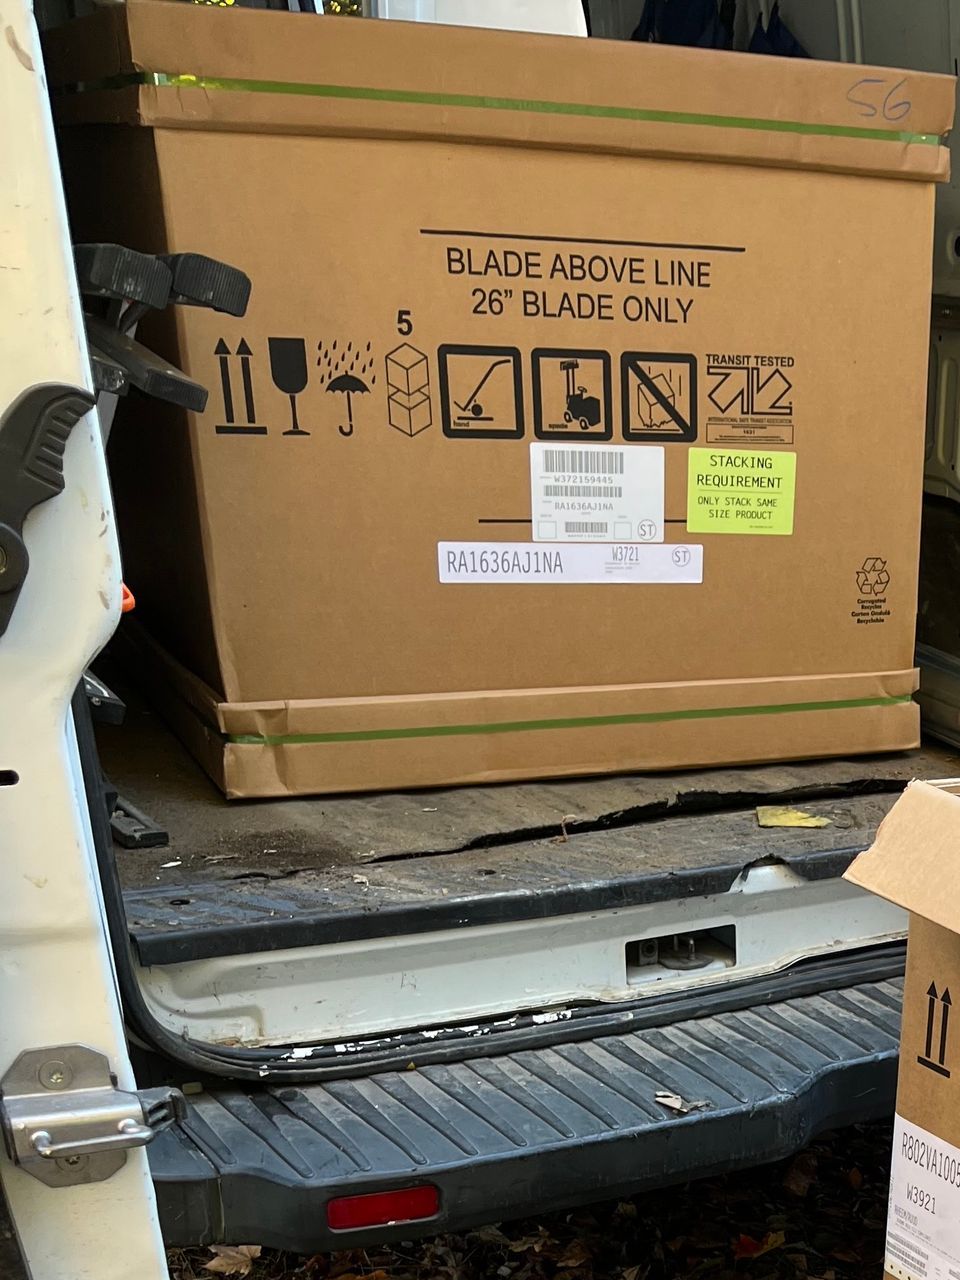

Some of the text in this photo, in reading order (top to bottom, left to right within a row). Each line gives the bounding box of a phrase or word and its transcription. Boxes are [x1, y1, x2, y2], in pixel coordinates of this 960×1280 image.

[446, 247, 711, 287] BLADE ABOVE LINE
[523, 290, 614, 320] BLADE
[623, 295, 694, 323] ONLY
[397, 310, 413, 335] 5
[706, 353, 795, 367] TRANSIT TESTED
[710, 455, 773, 469] STACKING
[554, 474, 613, 484] W372159445
[696, 474, 783, 488] REQUIREMENT
[554, 502, 614, 511] RA1636AJ1NA
[697, 496, 778, 507] ONLY STACK SAME
[709, 509, 773, 520] SIZE PRODUCT
[640, 523, 654, 537] ST
[612, 546, 640, 561] W3721
[674, 550, 689, 564] ST
[447, 550, 563, 574] RA1636AJ1NA
[906, 1182, 936, 1215] W3921
